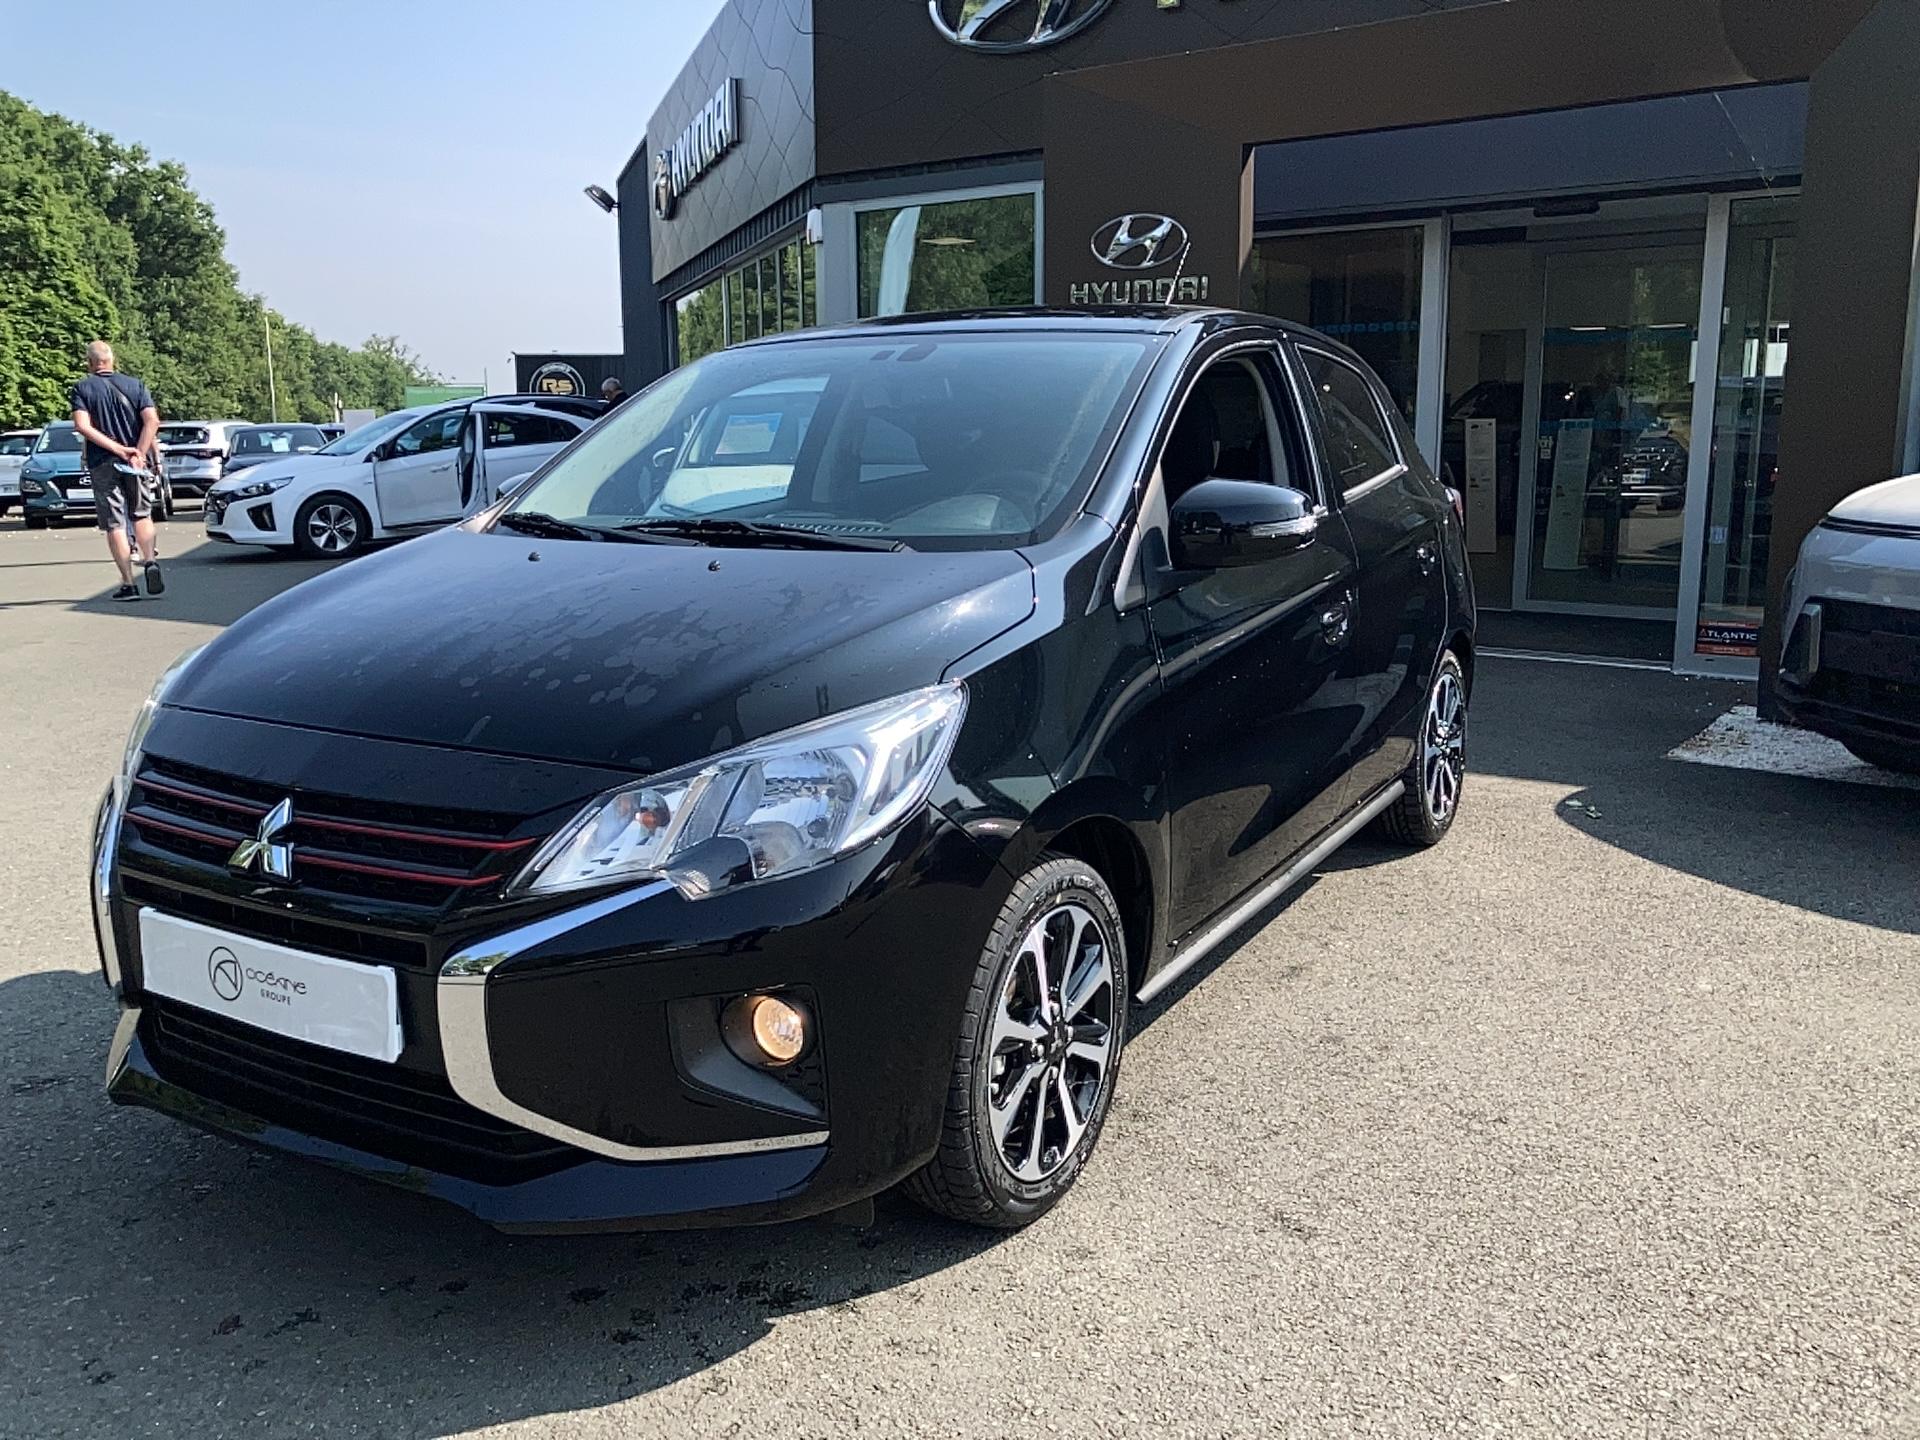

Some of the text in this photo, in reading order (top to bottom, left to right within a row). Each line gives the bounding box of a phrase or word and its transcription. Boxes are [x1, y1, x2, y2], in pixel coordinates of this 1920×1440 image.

[671, 77, 737, 197] HYUNDAI
[1070, 275, 1209, 304] HYUNDAI
[541, 378, 574, 395] RS
[1699, 628, 1758, 640] ATLANTIC
